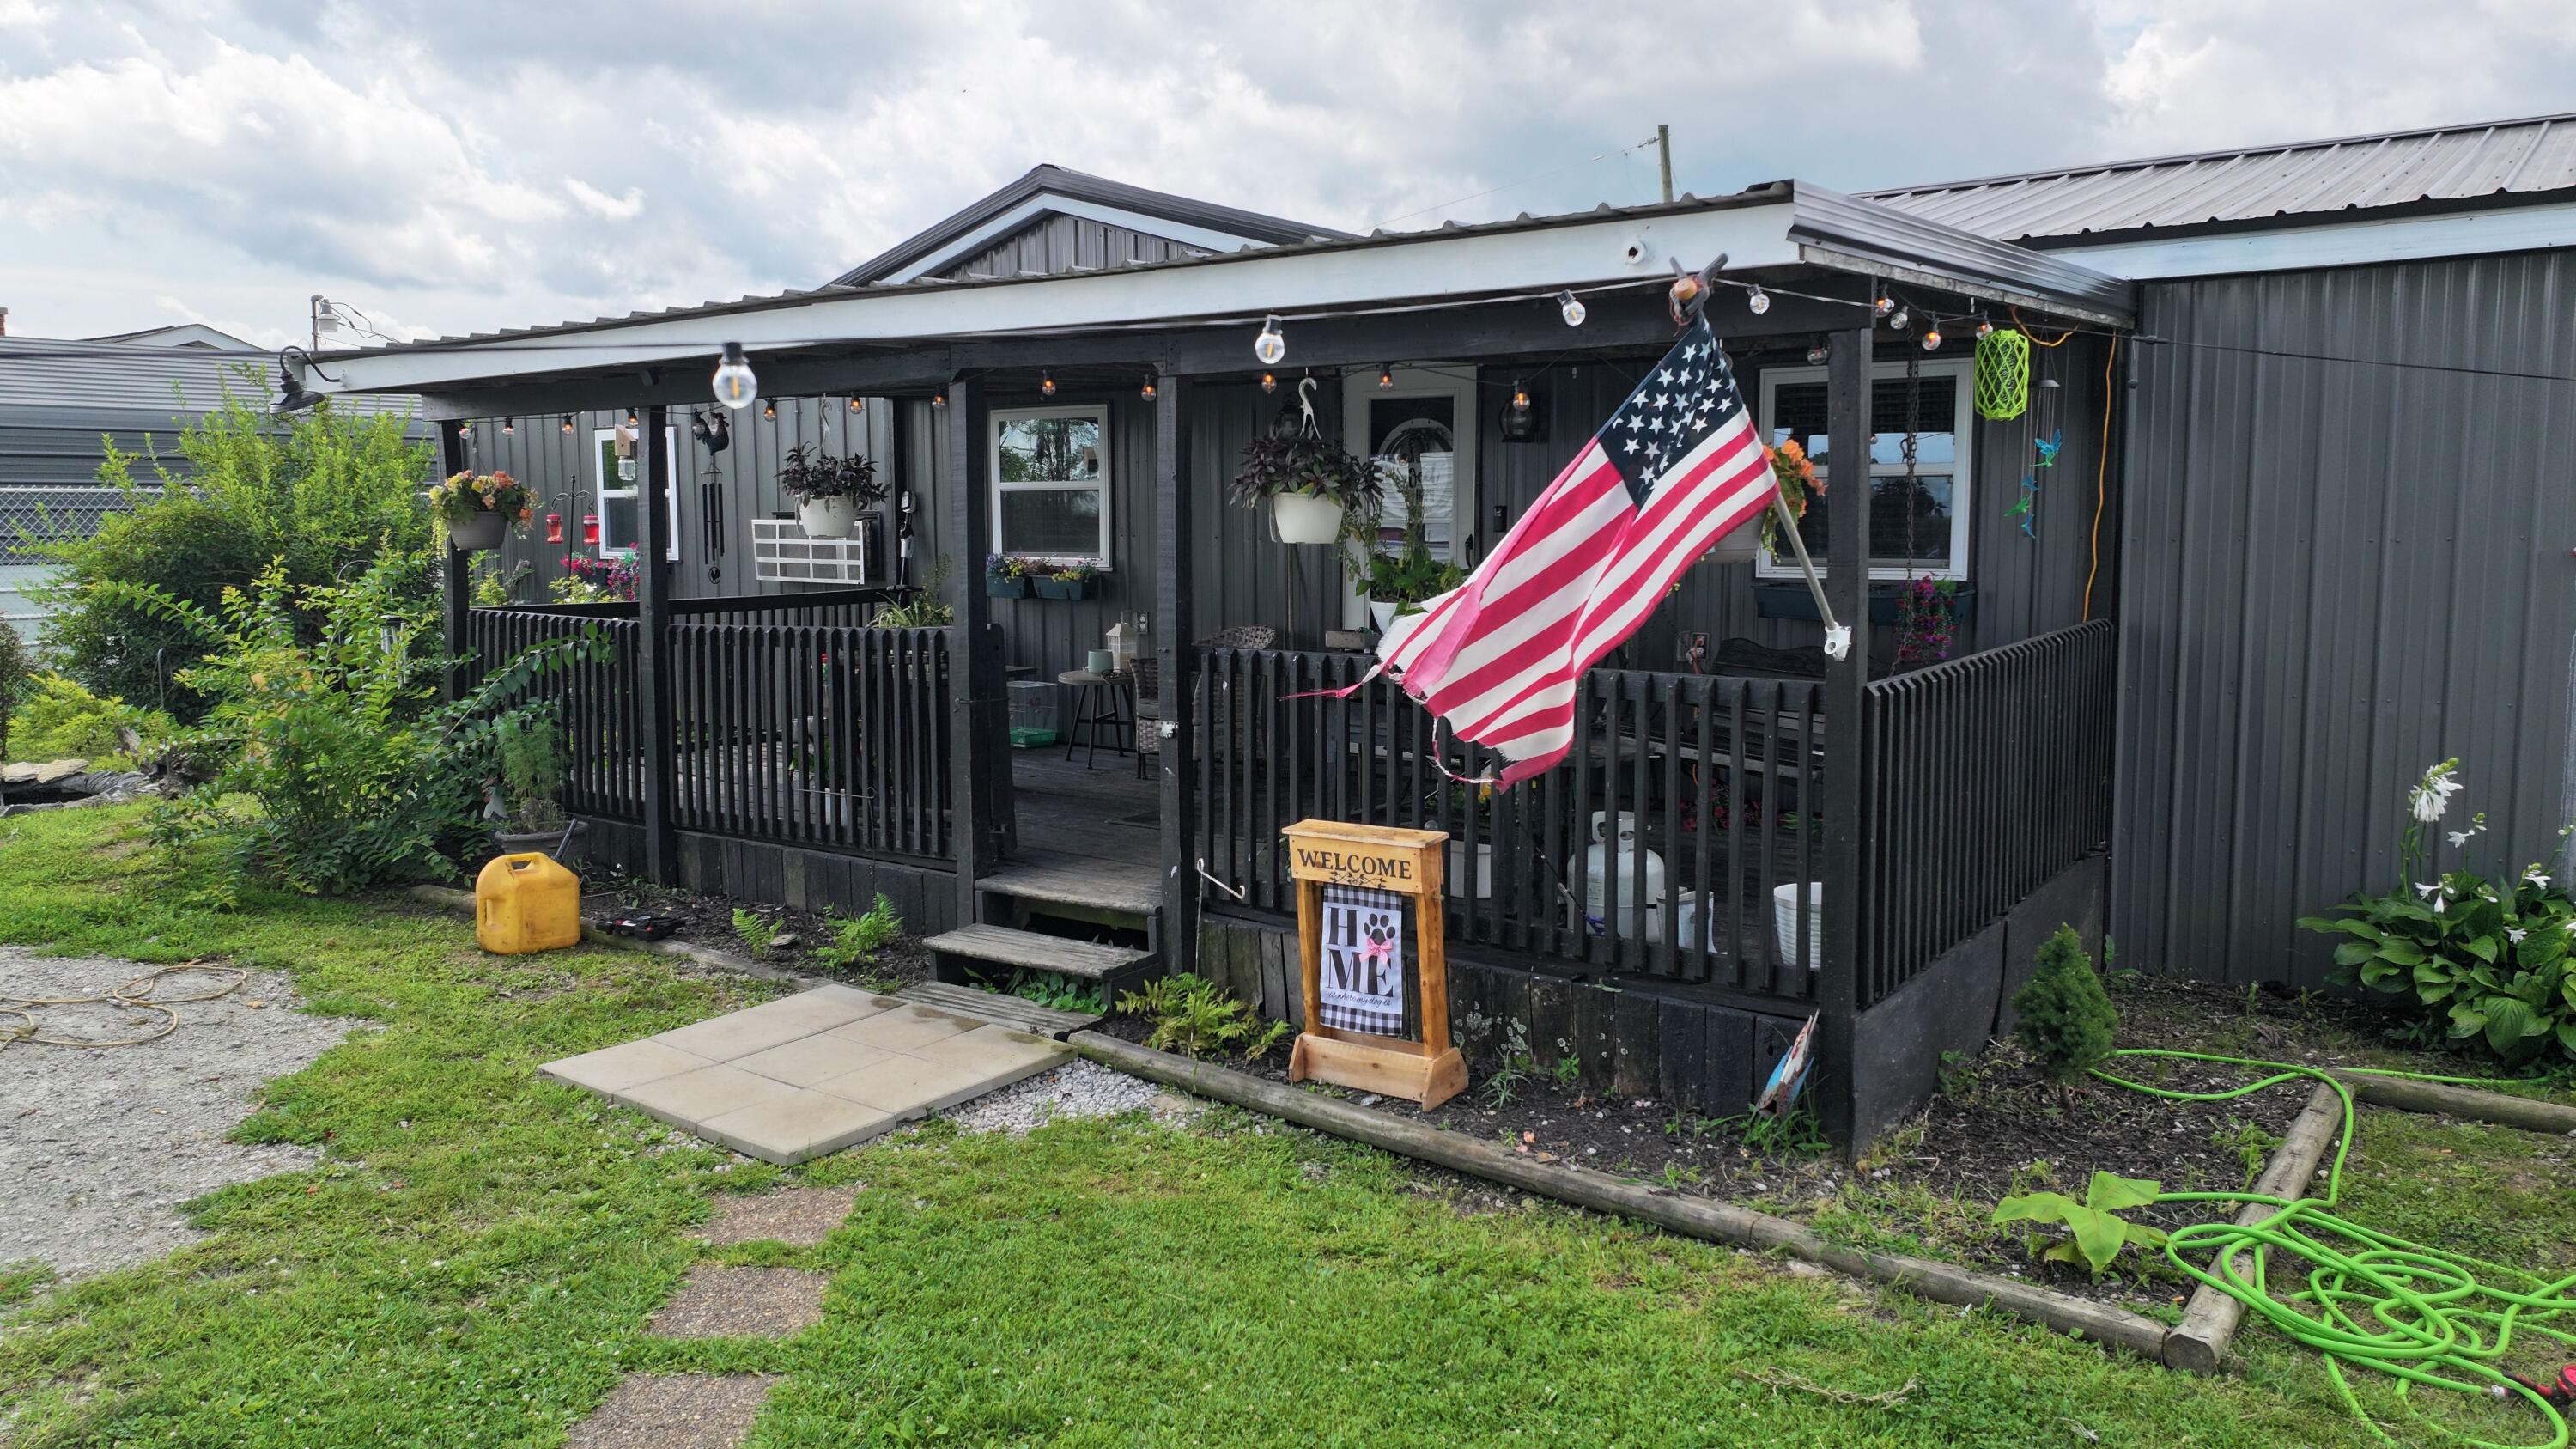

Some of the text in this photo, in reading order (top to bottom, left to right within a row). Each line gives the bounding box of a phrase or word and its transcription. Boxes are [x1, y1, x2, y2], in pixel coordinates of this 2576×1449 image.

[1297, 849, 1412, 880] WELCOME
[1357, 995, 1368, 1006] my
[1370, 996, 1382, 1008] dog
